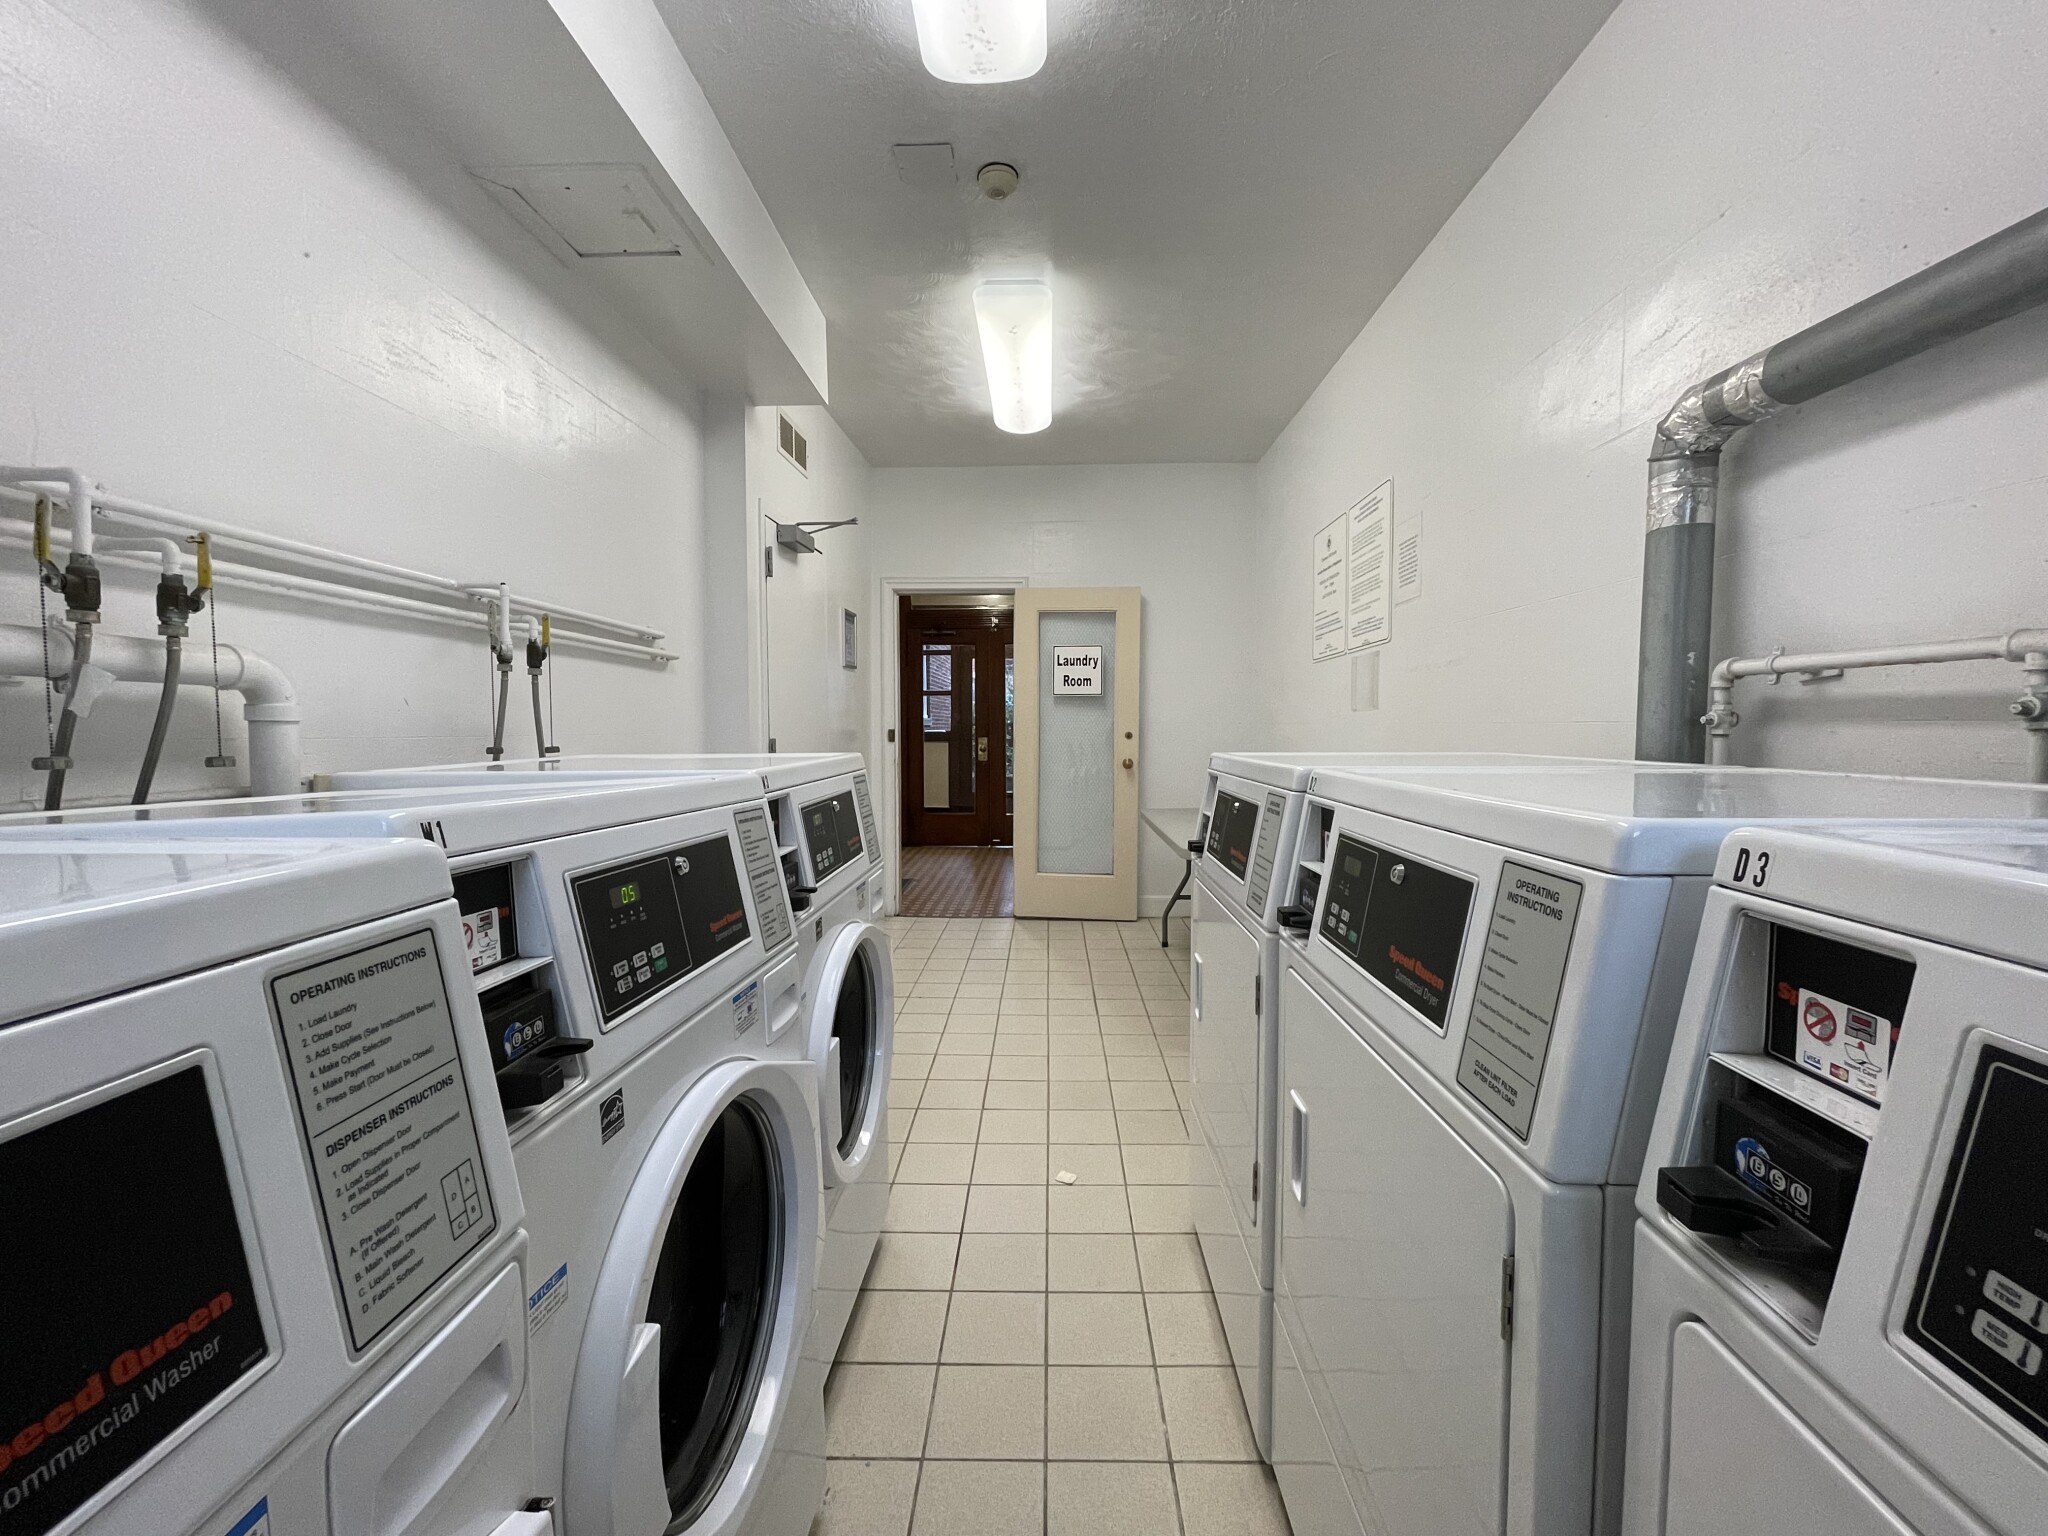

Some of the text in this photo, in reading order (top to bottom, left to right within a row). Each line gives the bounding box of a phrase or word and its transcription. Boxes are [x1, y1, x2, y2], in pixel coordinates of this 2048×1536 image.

[1057, 654, 1098, 669] Laundry
[1063, 675, 1092, 686] Room
[420, 820, 448, 849] W1
[621, 885, 636, 904] 05
[1507, 891, 1563, 921] INSTRUCTIONS
[1516, 879, 1560, 902] OPERATING
[289, 947, 426, 1005] OPERATING INSTRUCTIONS
[1423, 988, 1438, 1006] Dryer
[298, 1002, 358, 1031] 1. Load Laundry
[302, 1020, 352, 1047] 2. Close Door
[305, 1000, 436, 1063] 3. Add Supplies (See Instructions Below)
[309, 1035, 392, 1079] 4. Make Cycle Selection
[313, 1059, 375, 1095] 5. Make Payment
[316, 1102, 323, 1111] 6.
[326, 1090, 347, 1106] Press
[349, 1080, 366, 1095] Start
[367, 1070, 386, 1087] (Door
[386, 1062, 402, 1075] Must
[403, 1057, 411, 1066] be
[1474, 1069, 1515, 1107] AFTER EACH LOAD
[1475, 1059, 1489, 1076] CLEAN
[1502, 1080, 1517, 1098] FILTER
[325, 1075, 453, 1157] DISPENSER INSTRUCTIONS
[333, 1125, 412, 1179] 1. Open Dispenser Door
[336, 1187, 343, 1198] 2.
[345, 1174, 363, 1191] Load
[364, 1155, 392, 1179] Supplies
[394, 1150, 400, 1158] in
[401, 1137, 421, 1155] Proper
[341, 1161, 421, 1222] 3. Close Dispenser Door
[451, 1191, 457, 1201] D
[349, 1193, 427, 1256] A. Pre Wash Detergent
[355, 1213, 436, 1282] B. Main Wash Detergent
[358, 1286, 366, 1298] C.
[369, 1267, 391, 1291] Liquid
[372, 1281, 394, 1304] Fabric
[396, 1257, 424, 1285] Softener
[529, 1271, 560, 1307] TICE
[0, 1291, 235, 1472] eed Queen
[0, 1335, 221, 1511] ommercial Washer
